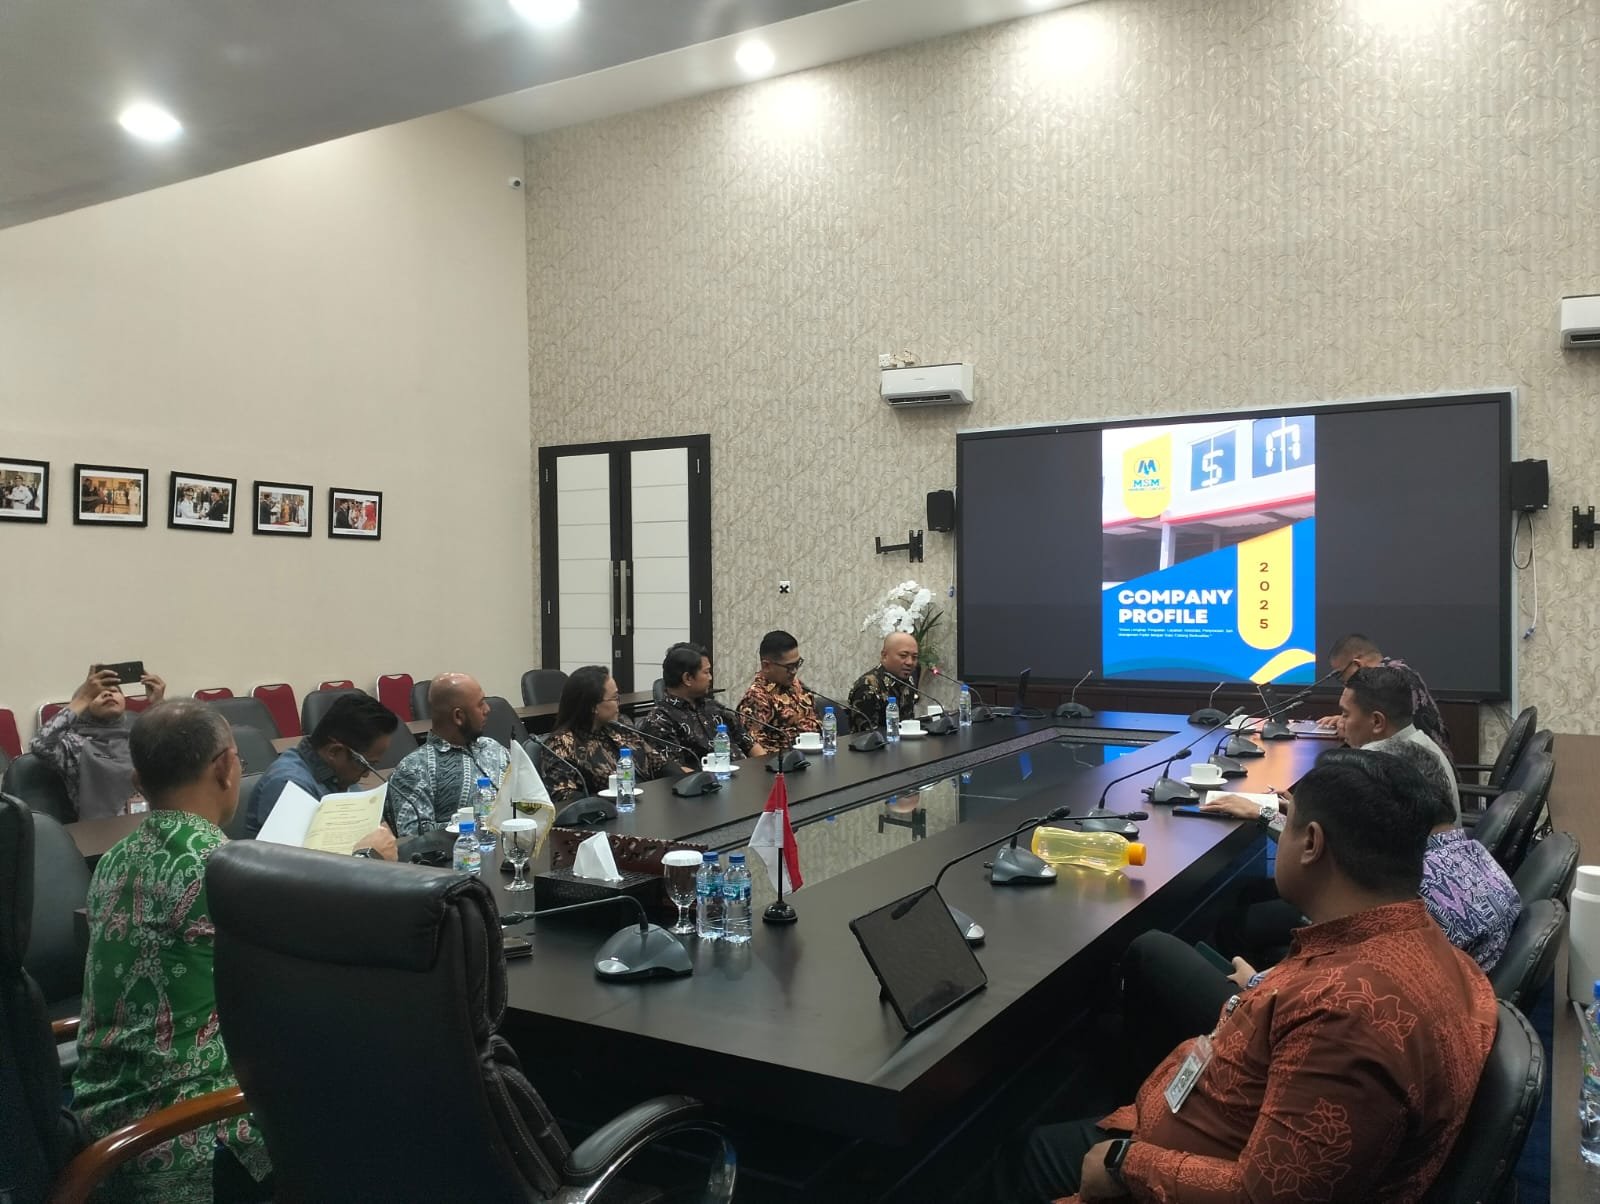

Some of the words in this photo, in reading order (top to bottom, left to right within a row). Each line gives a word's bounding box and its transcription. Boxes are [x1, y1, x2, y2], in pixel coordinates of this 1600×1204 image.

[1133, 478, 1161, 488] MSM
[1117, 588, 1234, 605] COMPANY
[1259, 562, 1270, 630] 2025
[1118, 608, 1209, 624] PROFILE
